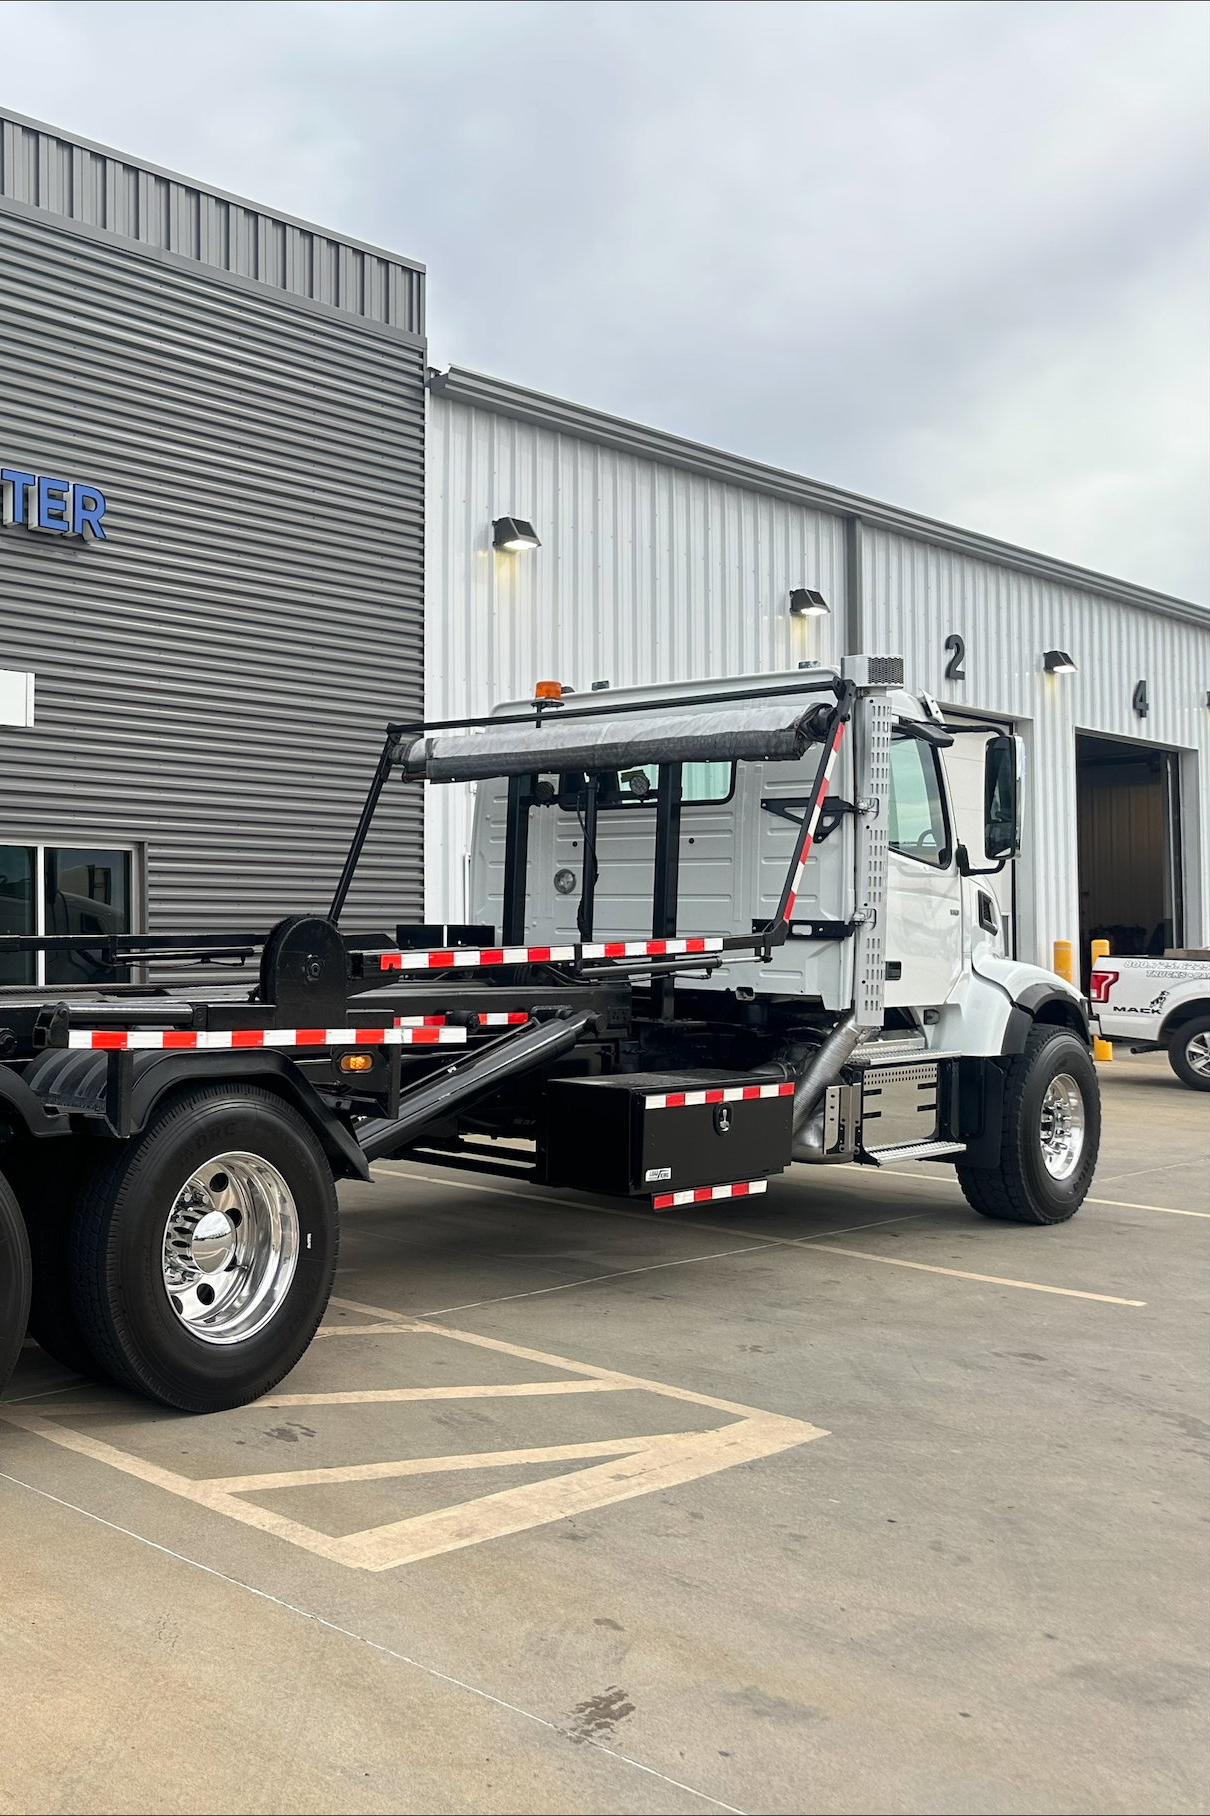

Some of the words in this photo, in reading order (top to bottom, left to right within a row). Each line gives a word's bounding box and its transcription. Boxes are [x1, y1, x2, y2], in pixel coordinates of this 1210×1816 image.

[945, 633, 965, 681] 2
[1133, 680, 1149, 718] 4
[1146, 970, 1187, 979] TRUCKS
[1113, 1006, 1161, 1015] MACK
